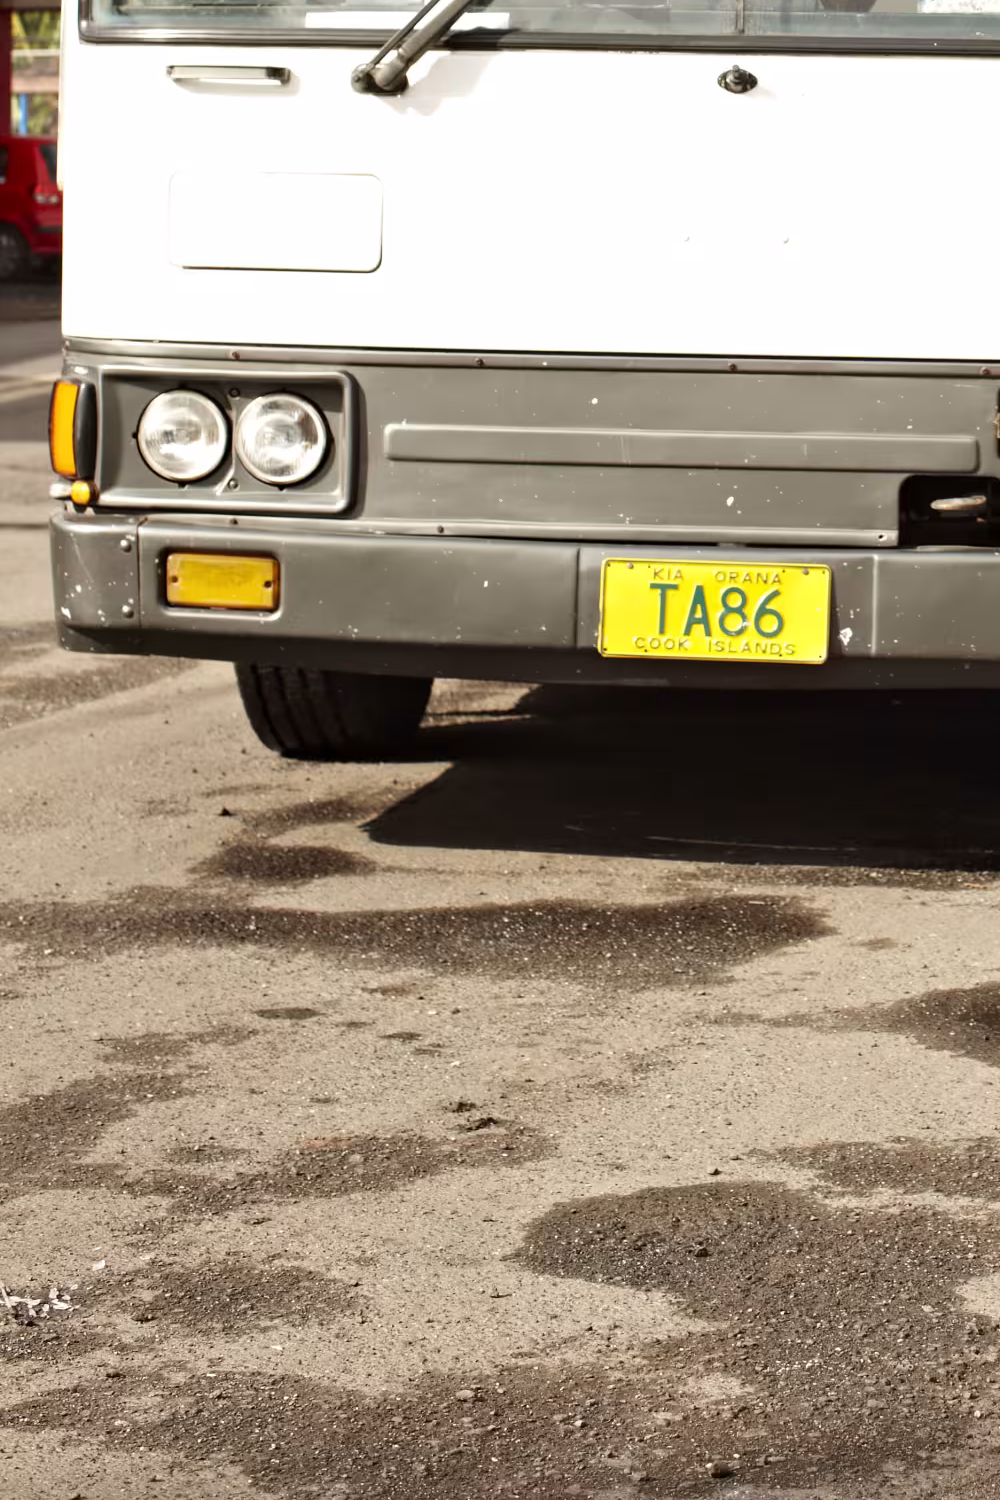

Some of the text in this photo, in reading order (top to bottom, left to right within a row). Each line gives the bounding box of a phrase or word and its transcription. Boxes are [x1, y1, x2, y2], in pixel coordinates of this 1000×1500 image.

[652, 567, 783, 585] KIA ORANA
[649, 582, 785, 639] TA86
[634, 636, 797, 656] COOK ISLANDS
